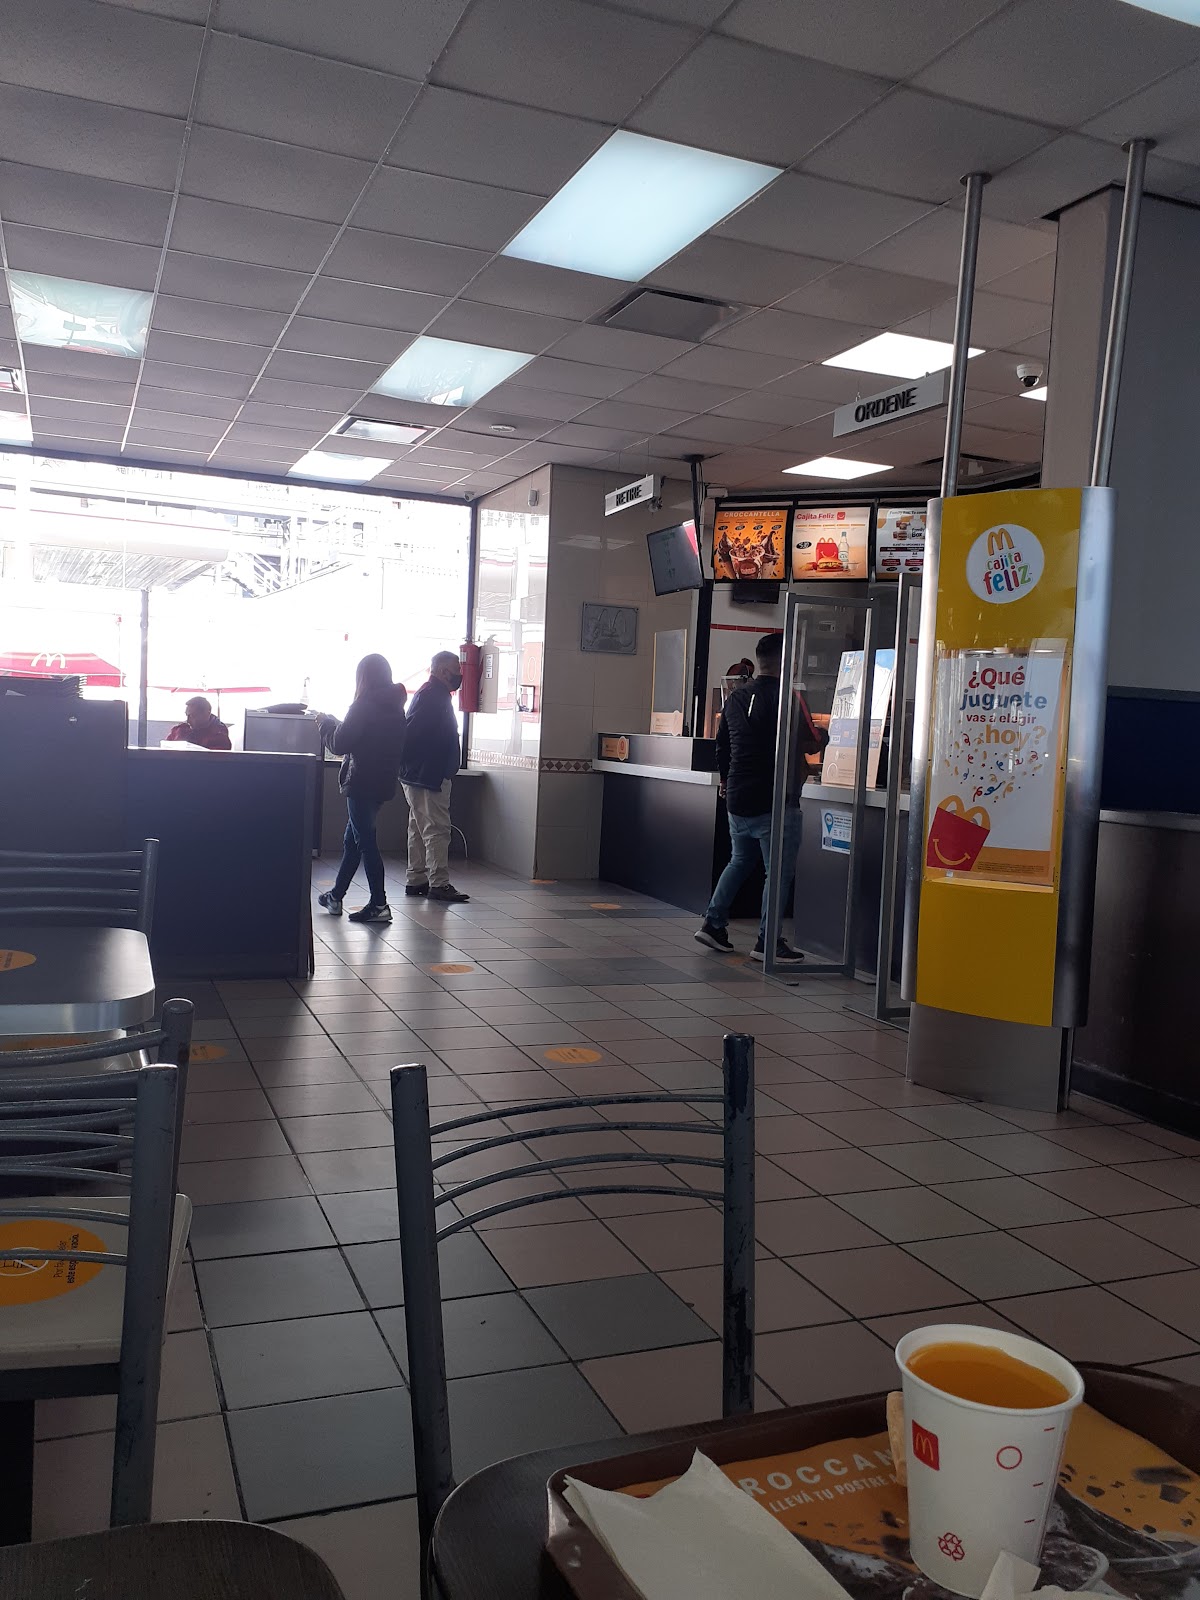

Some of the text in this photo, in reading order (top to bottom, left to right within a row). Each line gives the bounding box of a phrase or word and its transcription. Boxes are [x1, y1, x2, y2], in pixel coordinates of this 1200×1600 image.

[854, 387, 918, 423] ORDENE
[615, 484, 642, 507] RETIRE
[796, 513, 817, 521] Cajita
[987, 552, 1022, 571] cajita
[983, 565, 1031, 595] feliz
[968, 665, 1025, 689] ¿Qué
[960, 689, 1047, 711] juguete
[966, 714, 986, 724] vas
[999, 713, 1037, 727] elegir
[985, 725, 1046, 752] hoy?
[738, 1449, 893, 1499] ROCCAN
[769, 1490, 814, 1513] LLEVÁ
[813, 1488, 834, 1501] TU
[834, 1476, 889, 1496] POSTRE
